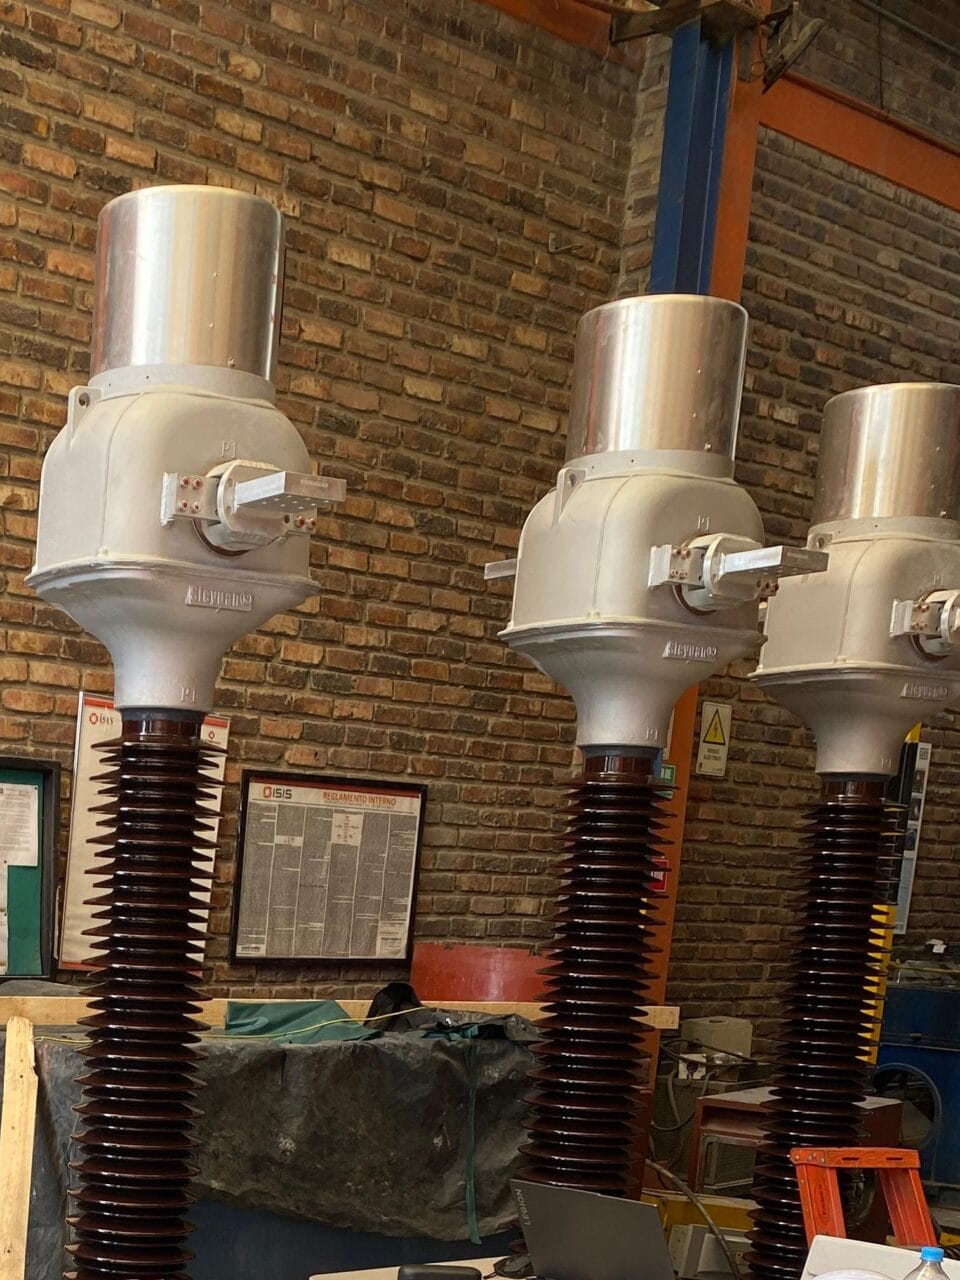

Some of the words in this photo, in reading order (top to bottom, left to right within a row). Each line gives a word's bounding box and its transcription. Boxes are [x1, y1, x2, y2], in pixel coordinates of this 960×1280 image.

[221, 440, 236, 458] P1
[181, 686, 196, 702] P1
[322, 791, 368, 804] REGLAMENTO
[368, 795, 397, 807] INTERNO
[515, 1188, 531, 1226] LEGION
